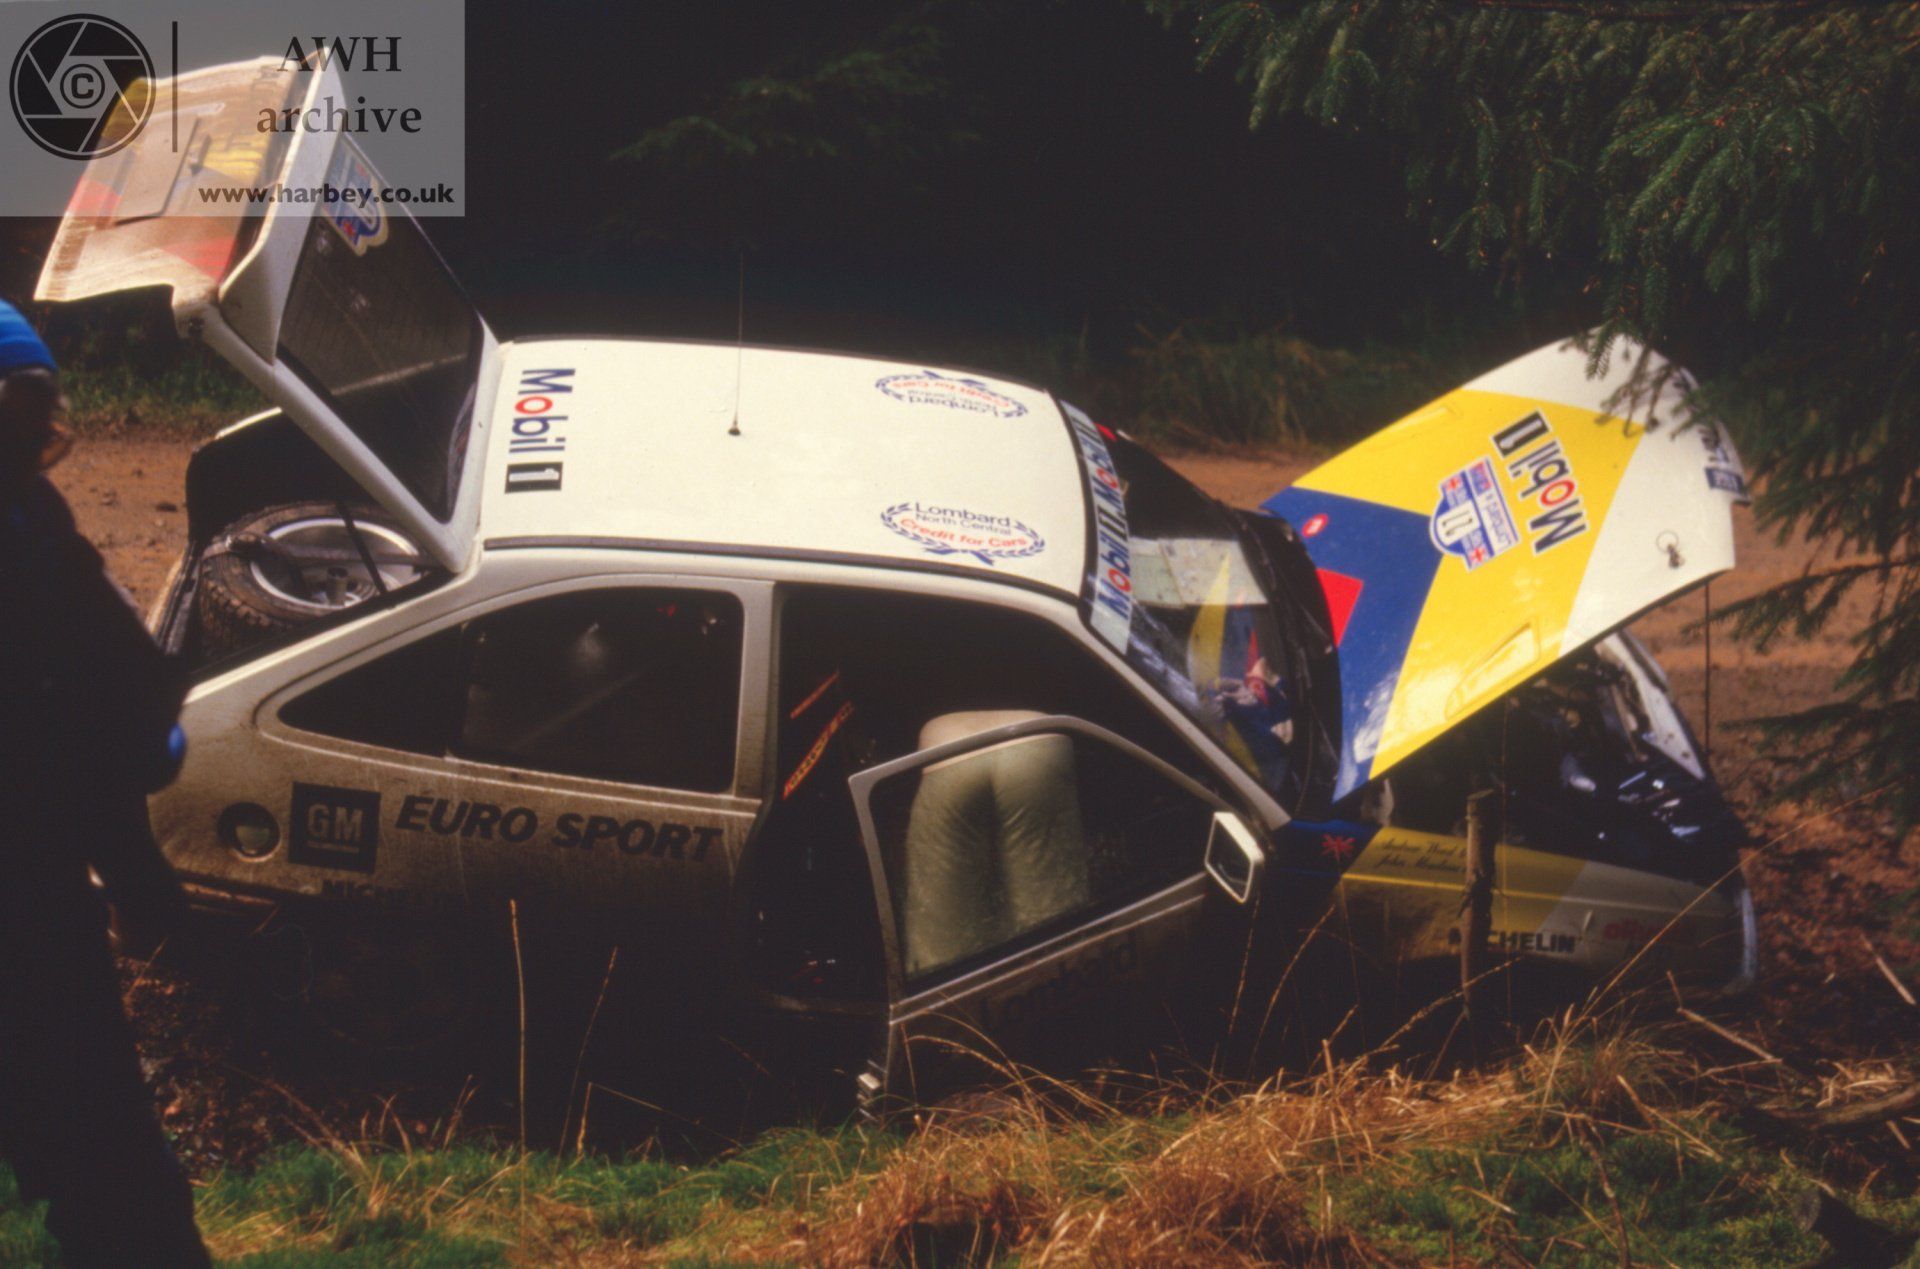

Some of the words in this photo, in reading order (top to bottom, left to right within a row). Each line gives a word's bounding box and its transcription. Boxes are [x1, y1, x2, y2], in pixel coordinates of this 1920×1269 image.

[508, 368, 576, 454] Mobil
[915, 501, 1011, 527] Lombard
[1508, 440, 1588, 553] Mobil
[900, 518, 955, 541] Credit
[959, 533, 983, 547] for
[987, 536, 1028, 548] Cars
[960, 519, 1011, 535] Central
[1097, 531, 1131, 620] Mobil
[306, 802, 363, 842] GM
[393, 794, 540, 844] EURO
[550, 811, 725, 862] SPORT
